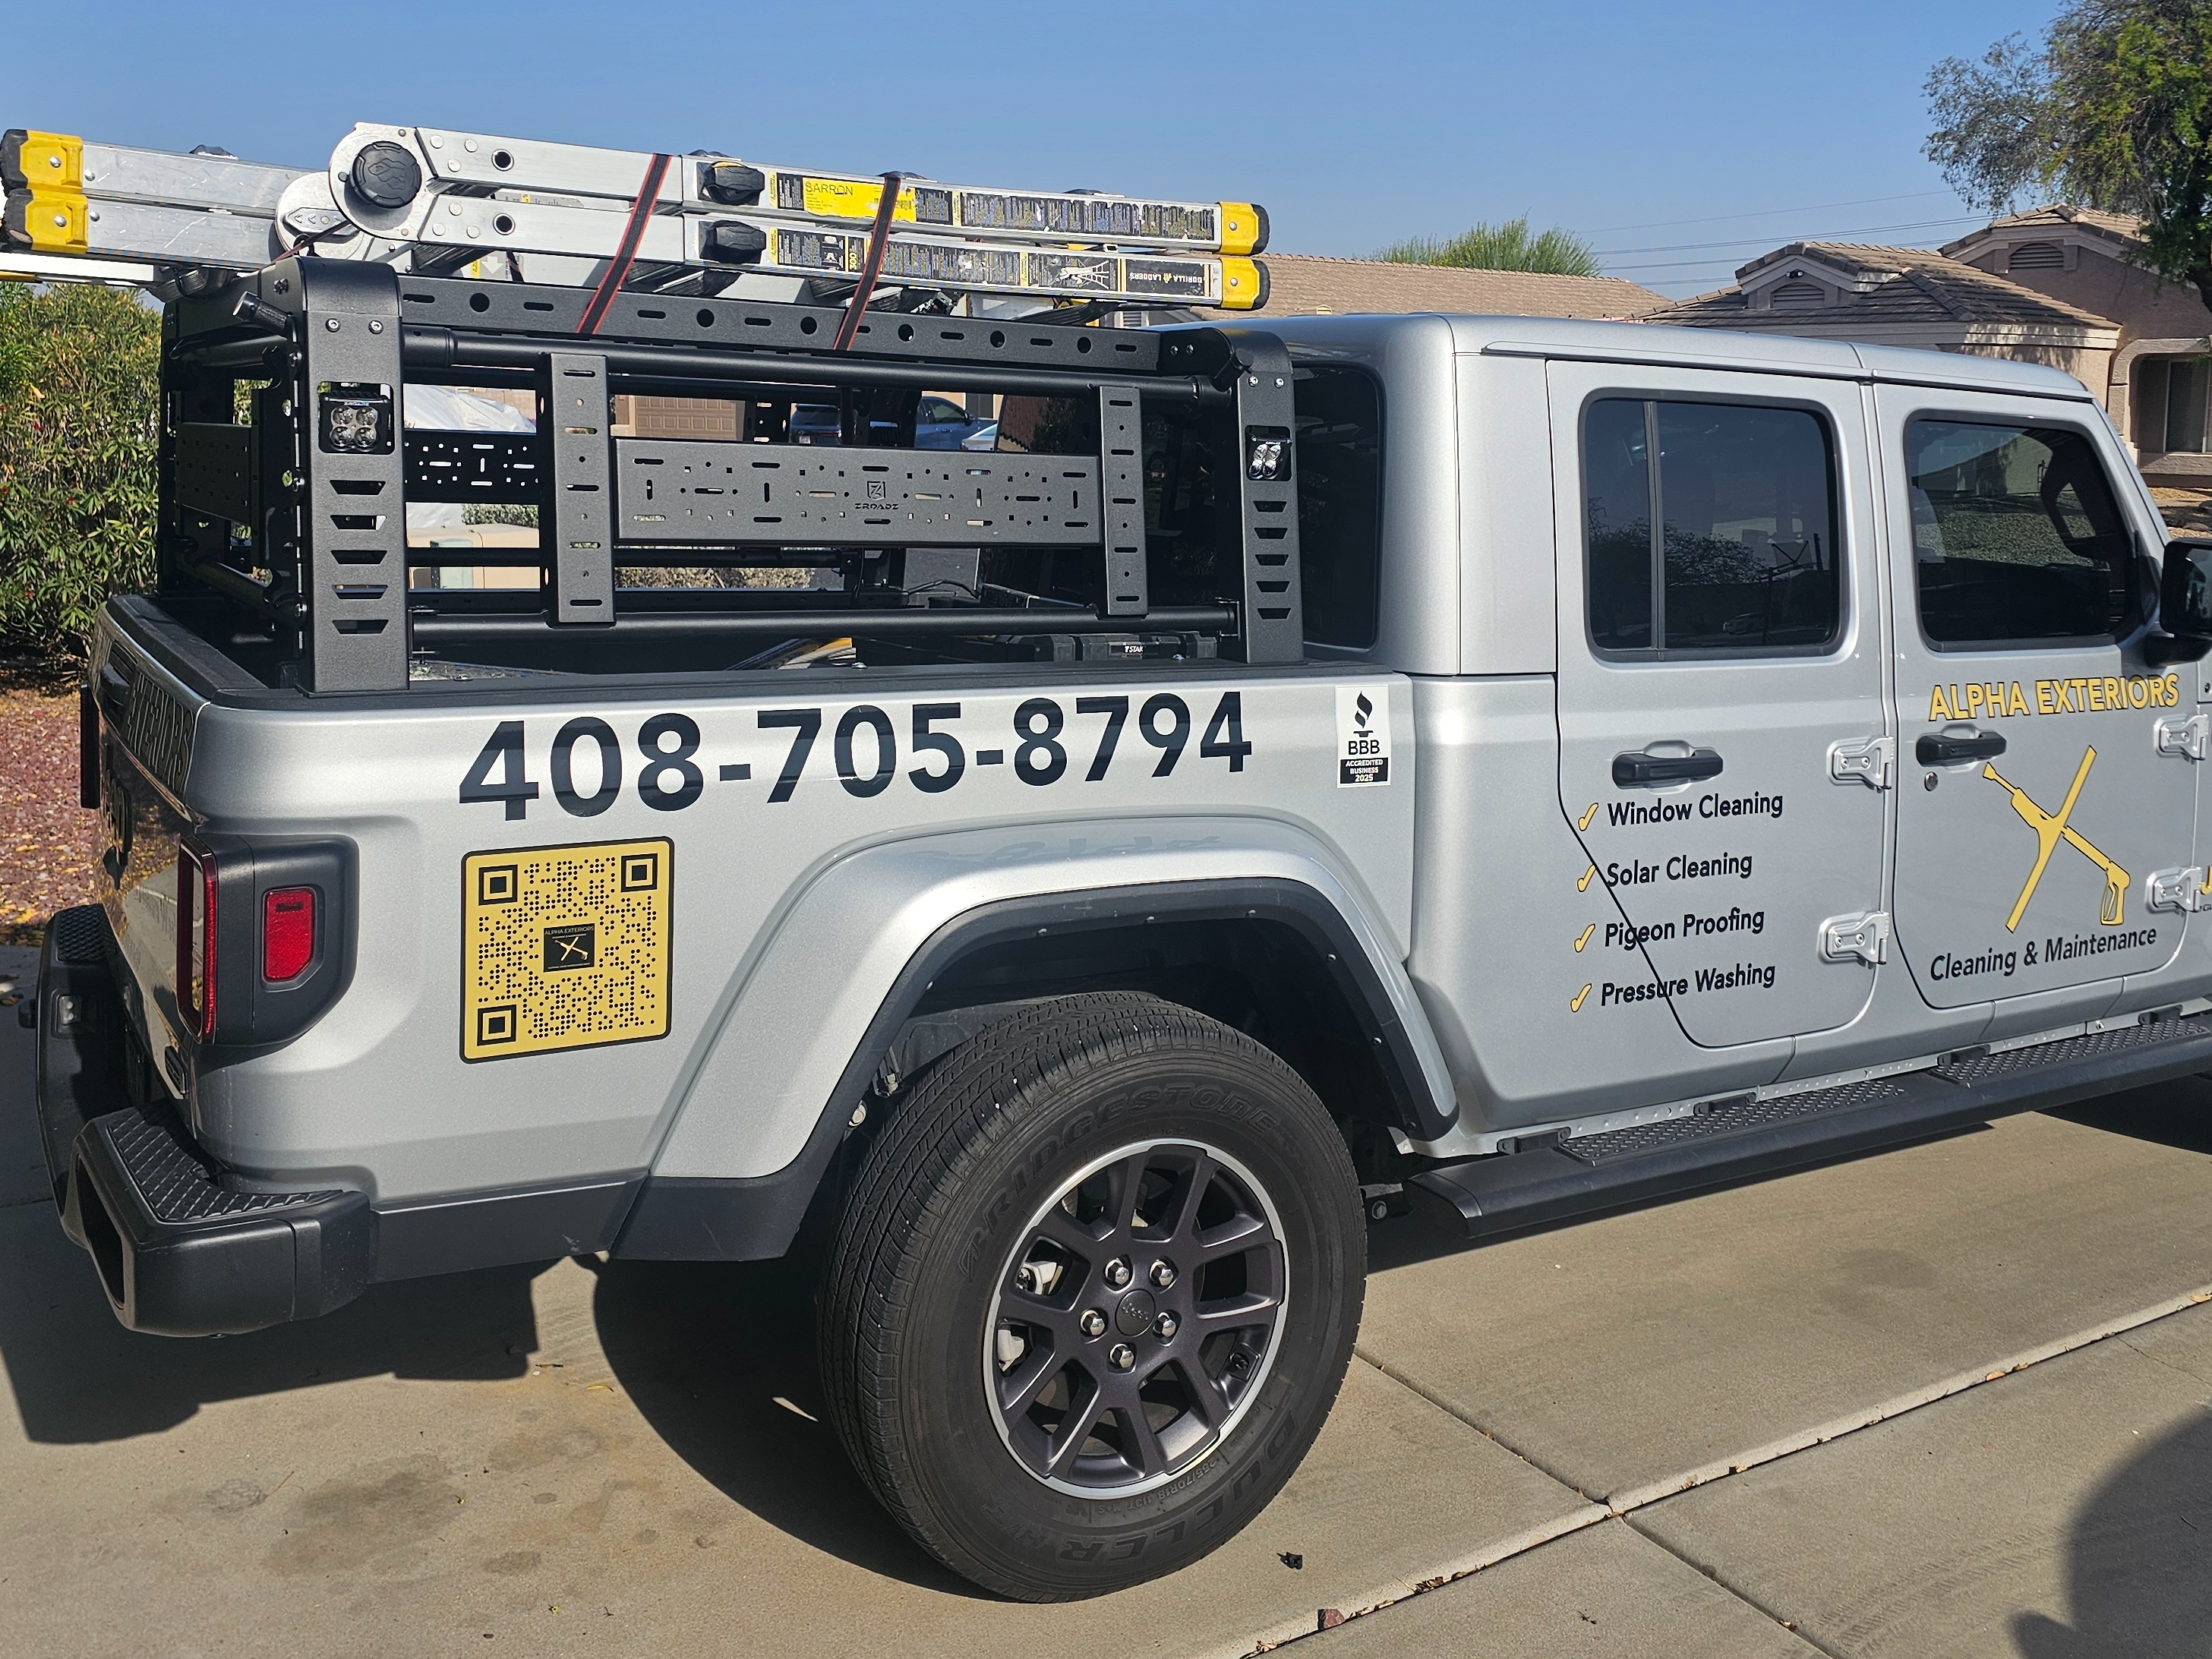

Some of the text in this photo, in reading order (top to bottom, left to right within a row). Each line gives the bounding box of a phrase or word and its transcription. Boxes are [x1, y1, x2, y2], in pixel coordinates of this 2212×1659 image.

[805, 181, 854, 195] SARRON
[1129, 273, 1203, 283] GORILLA LADDERS
[1928, 673, 2179, 721] ALPHA EXTERIORS
[459, 690, 1251, 821] 408-705-8794
[1348, 740, 1381, 755] BBB
[1349, 766, 1379, 774] BUSINESS
[1355, 774, 1374, 783] 2025
[1608, 791, 1783, 826] Window Cleaning
[1607, 852, 1753, 888] Solar Cleaning
[1605, 907, 1765, 951] Pigeon Proofing
[1930, 927, 2157, 981] Cleaning & Maintenance
[1601, 963, 1775, 1007] Pressure Washing
[958, 1082, 1280, 1283] BRIDGESTONE
[1157, 1458, 1216, 1500] 255/70R18
[1128, 1494, 1153, 1510] 113T
